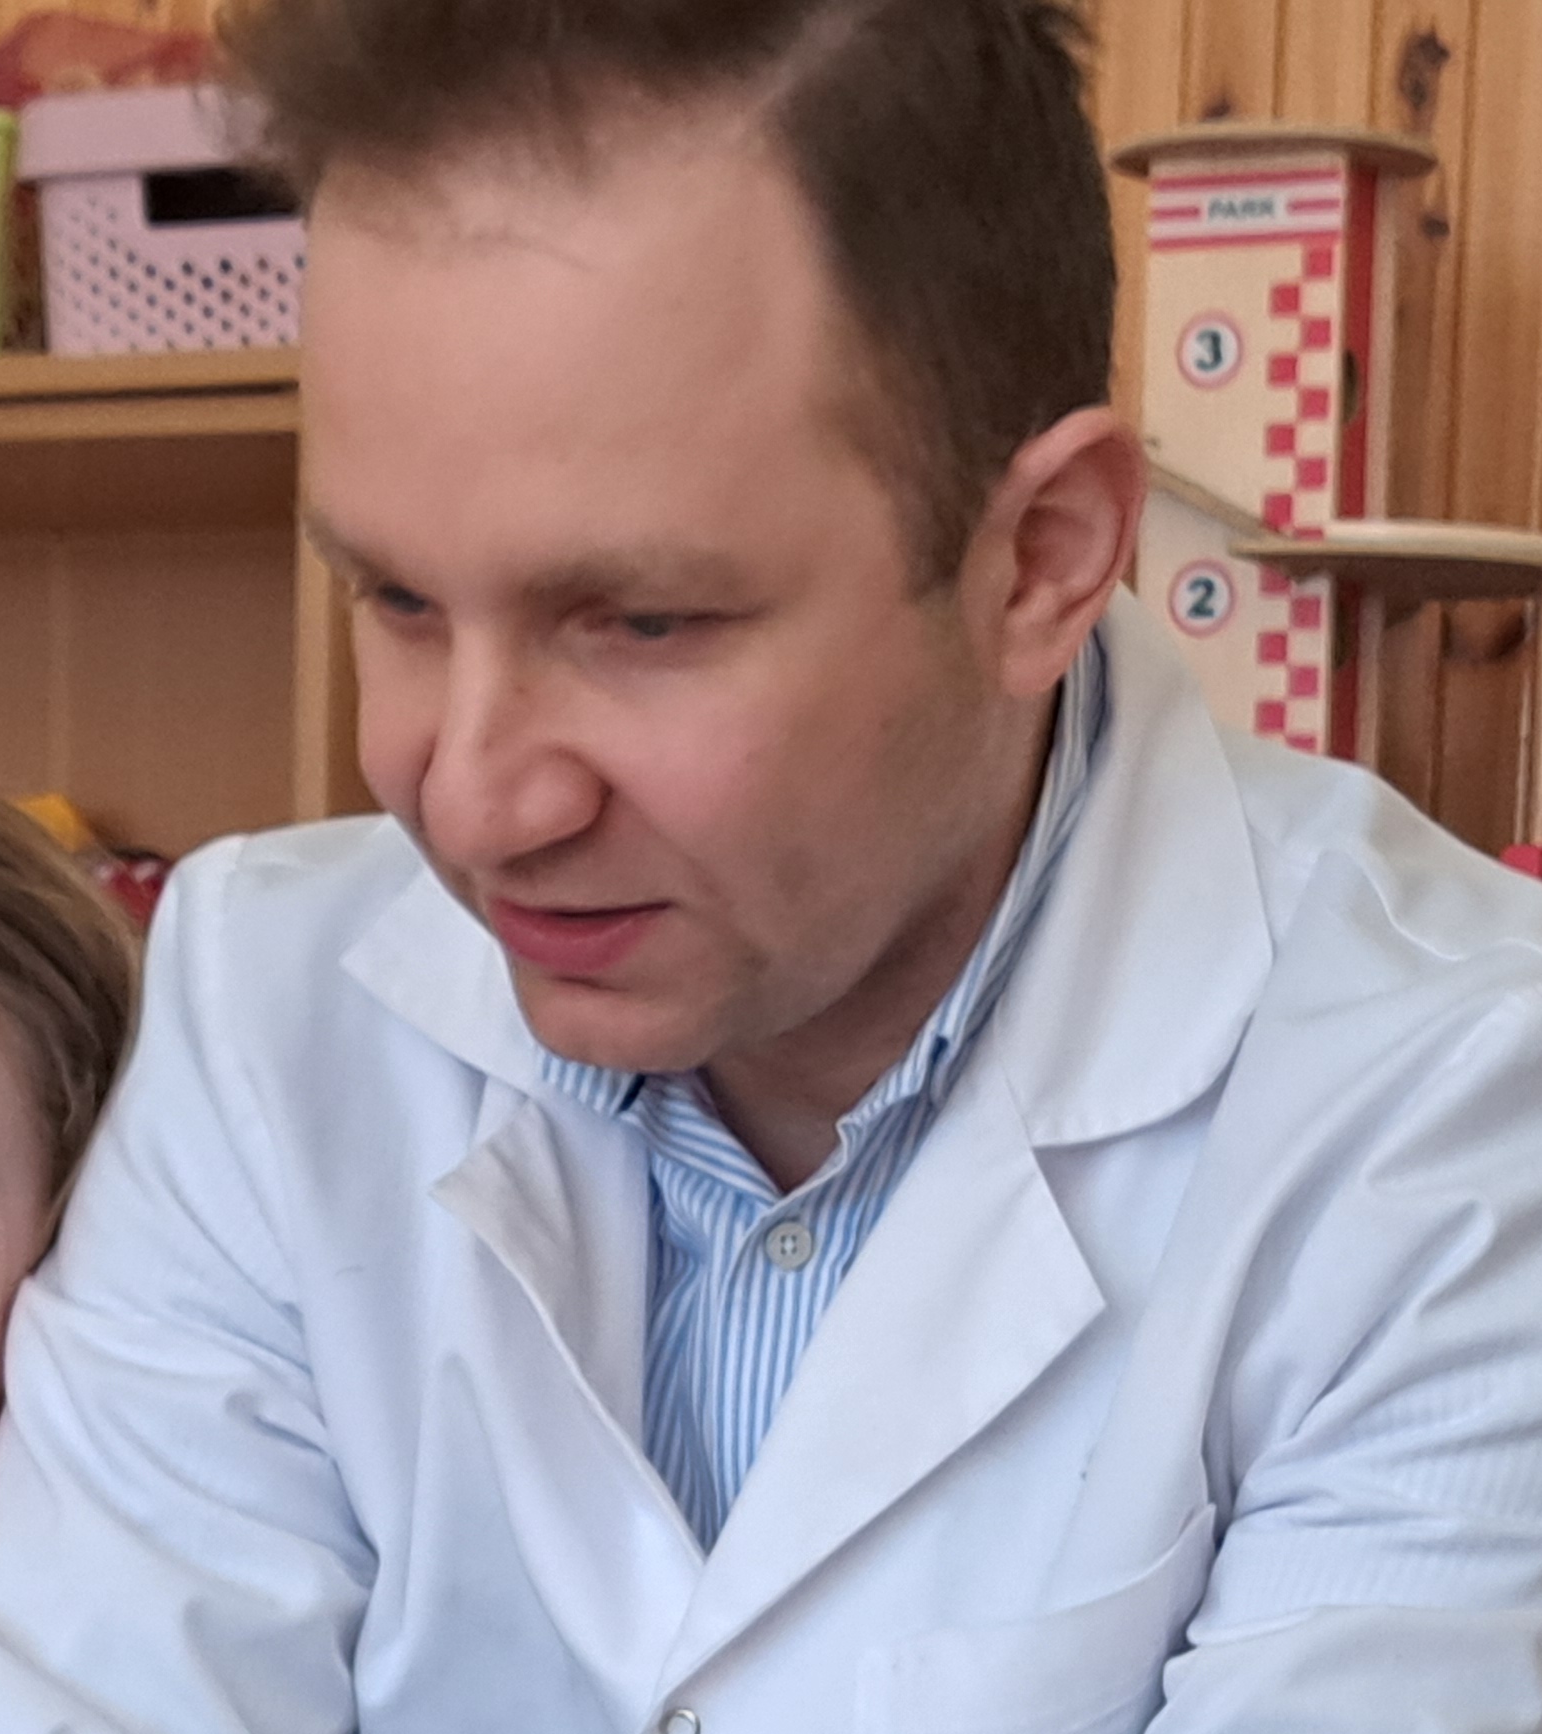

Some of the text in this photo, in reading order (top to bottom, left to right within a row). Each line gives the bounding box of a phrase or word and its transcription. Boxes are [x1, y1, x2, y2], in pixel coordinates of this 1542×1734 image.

[1207, 196, 1276, 221] PARK
[1195, 328, 1223, 373] 3
[1186, 577, 1216, 620] 2
